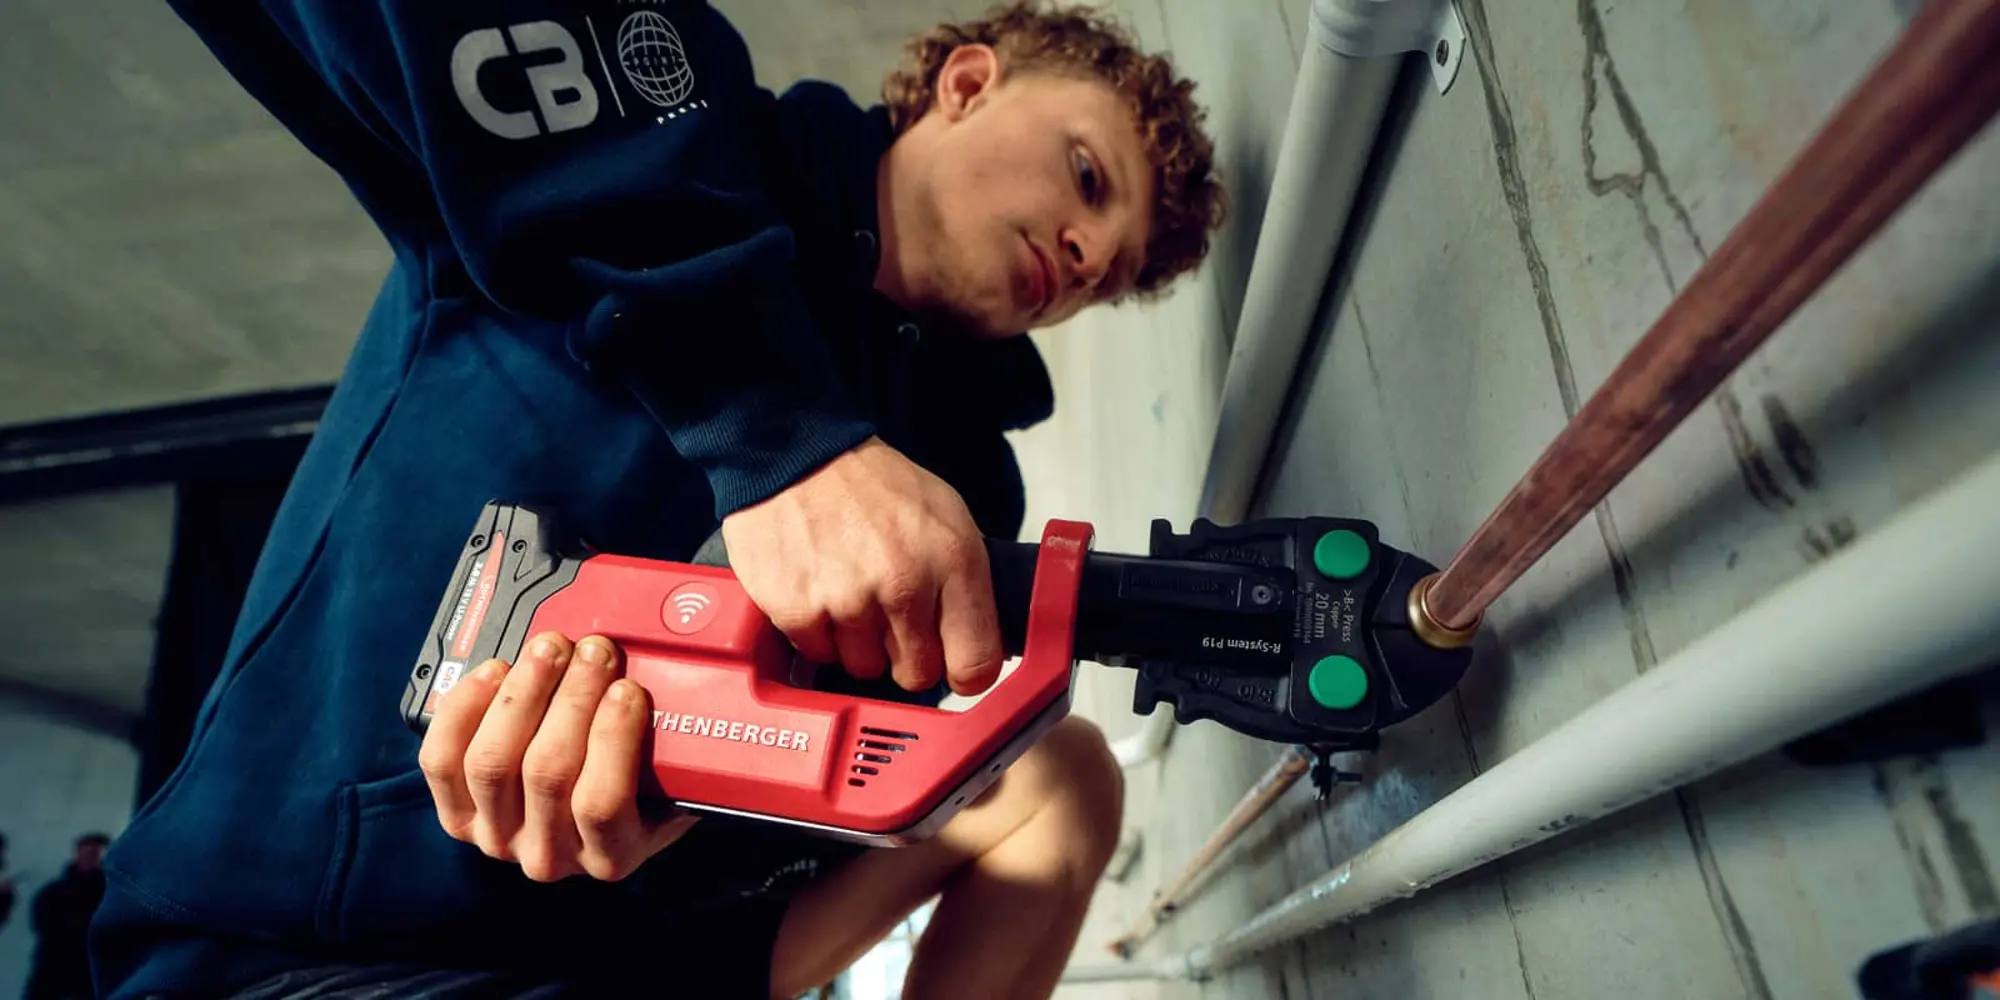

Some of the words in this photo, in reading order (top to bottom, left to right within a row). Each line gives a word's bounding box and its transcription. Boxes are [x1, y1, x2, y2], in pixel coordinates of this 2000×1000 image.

[451, 20, 599, 139] CB
[1315, 592, 1330, 609] 20
[1314, 612, 1325, 638] mm
[1342, 614, 1354, 642] Press
[1202, 636, 1224, 649] P19
[1227, 639, 1281, 654] R-System
[653, 709, 810, 752] THENBERGER
